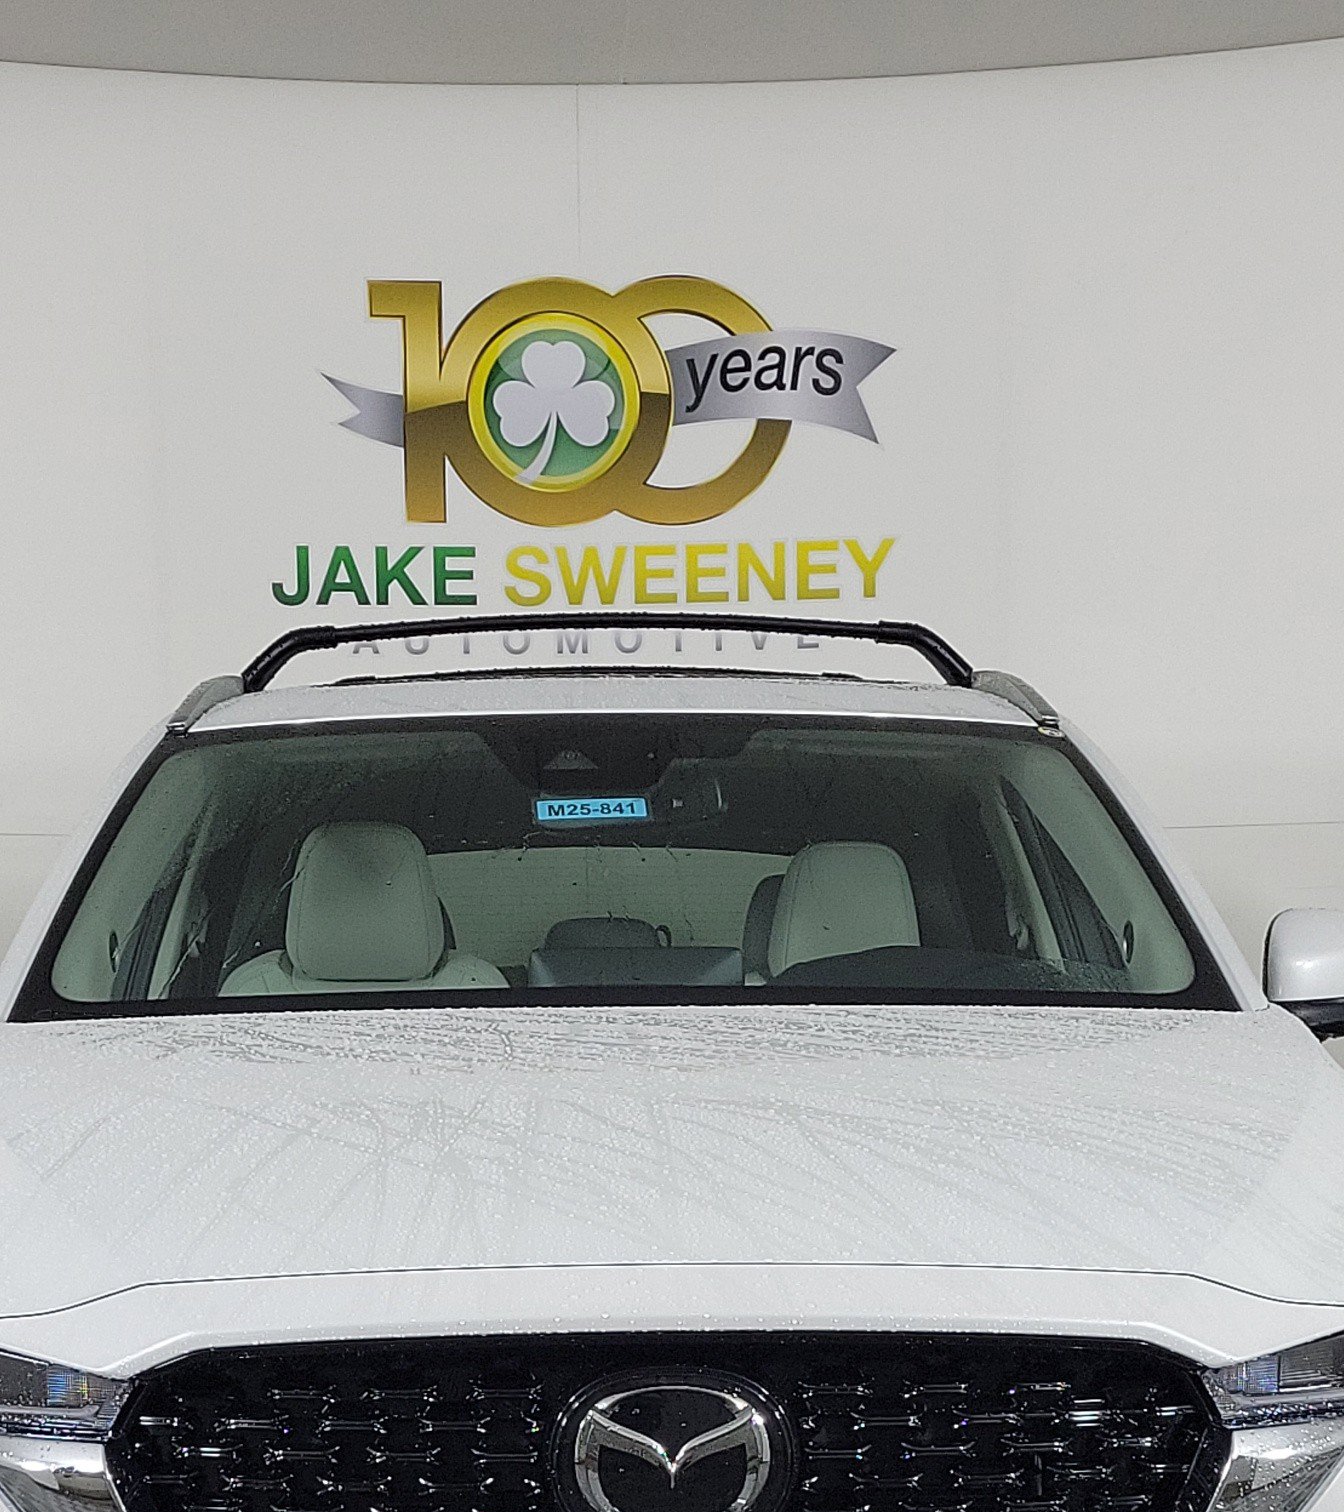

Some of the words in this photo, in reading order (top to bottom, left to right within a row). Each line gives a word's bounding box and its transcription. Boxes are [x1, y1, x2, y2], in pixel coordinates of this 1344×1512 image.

[367, 275, 793, 528] 100
[684, 344, 845, 413] years
[271, 546, 477, 607] JAKE
[504, 538, 895, 607] SWEENEY
[547, 802, 637, 817] M25-841
